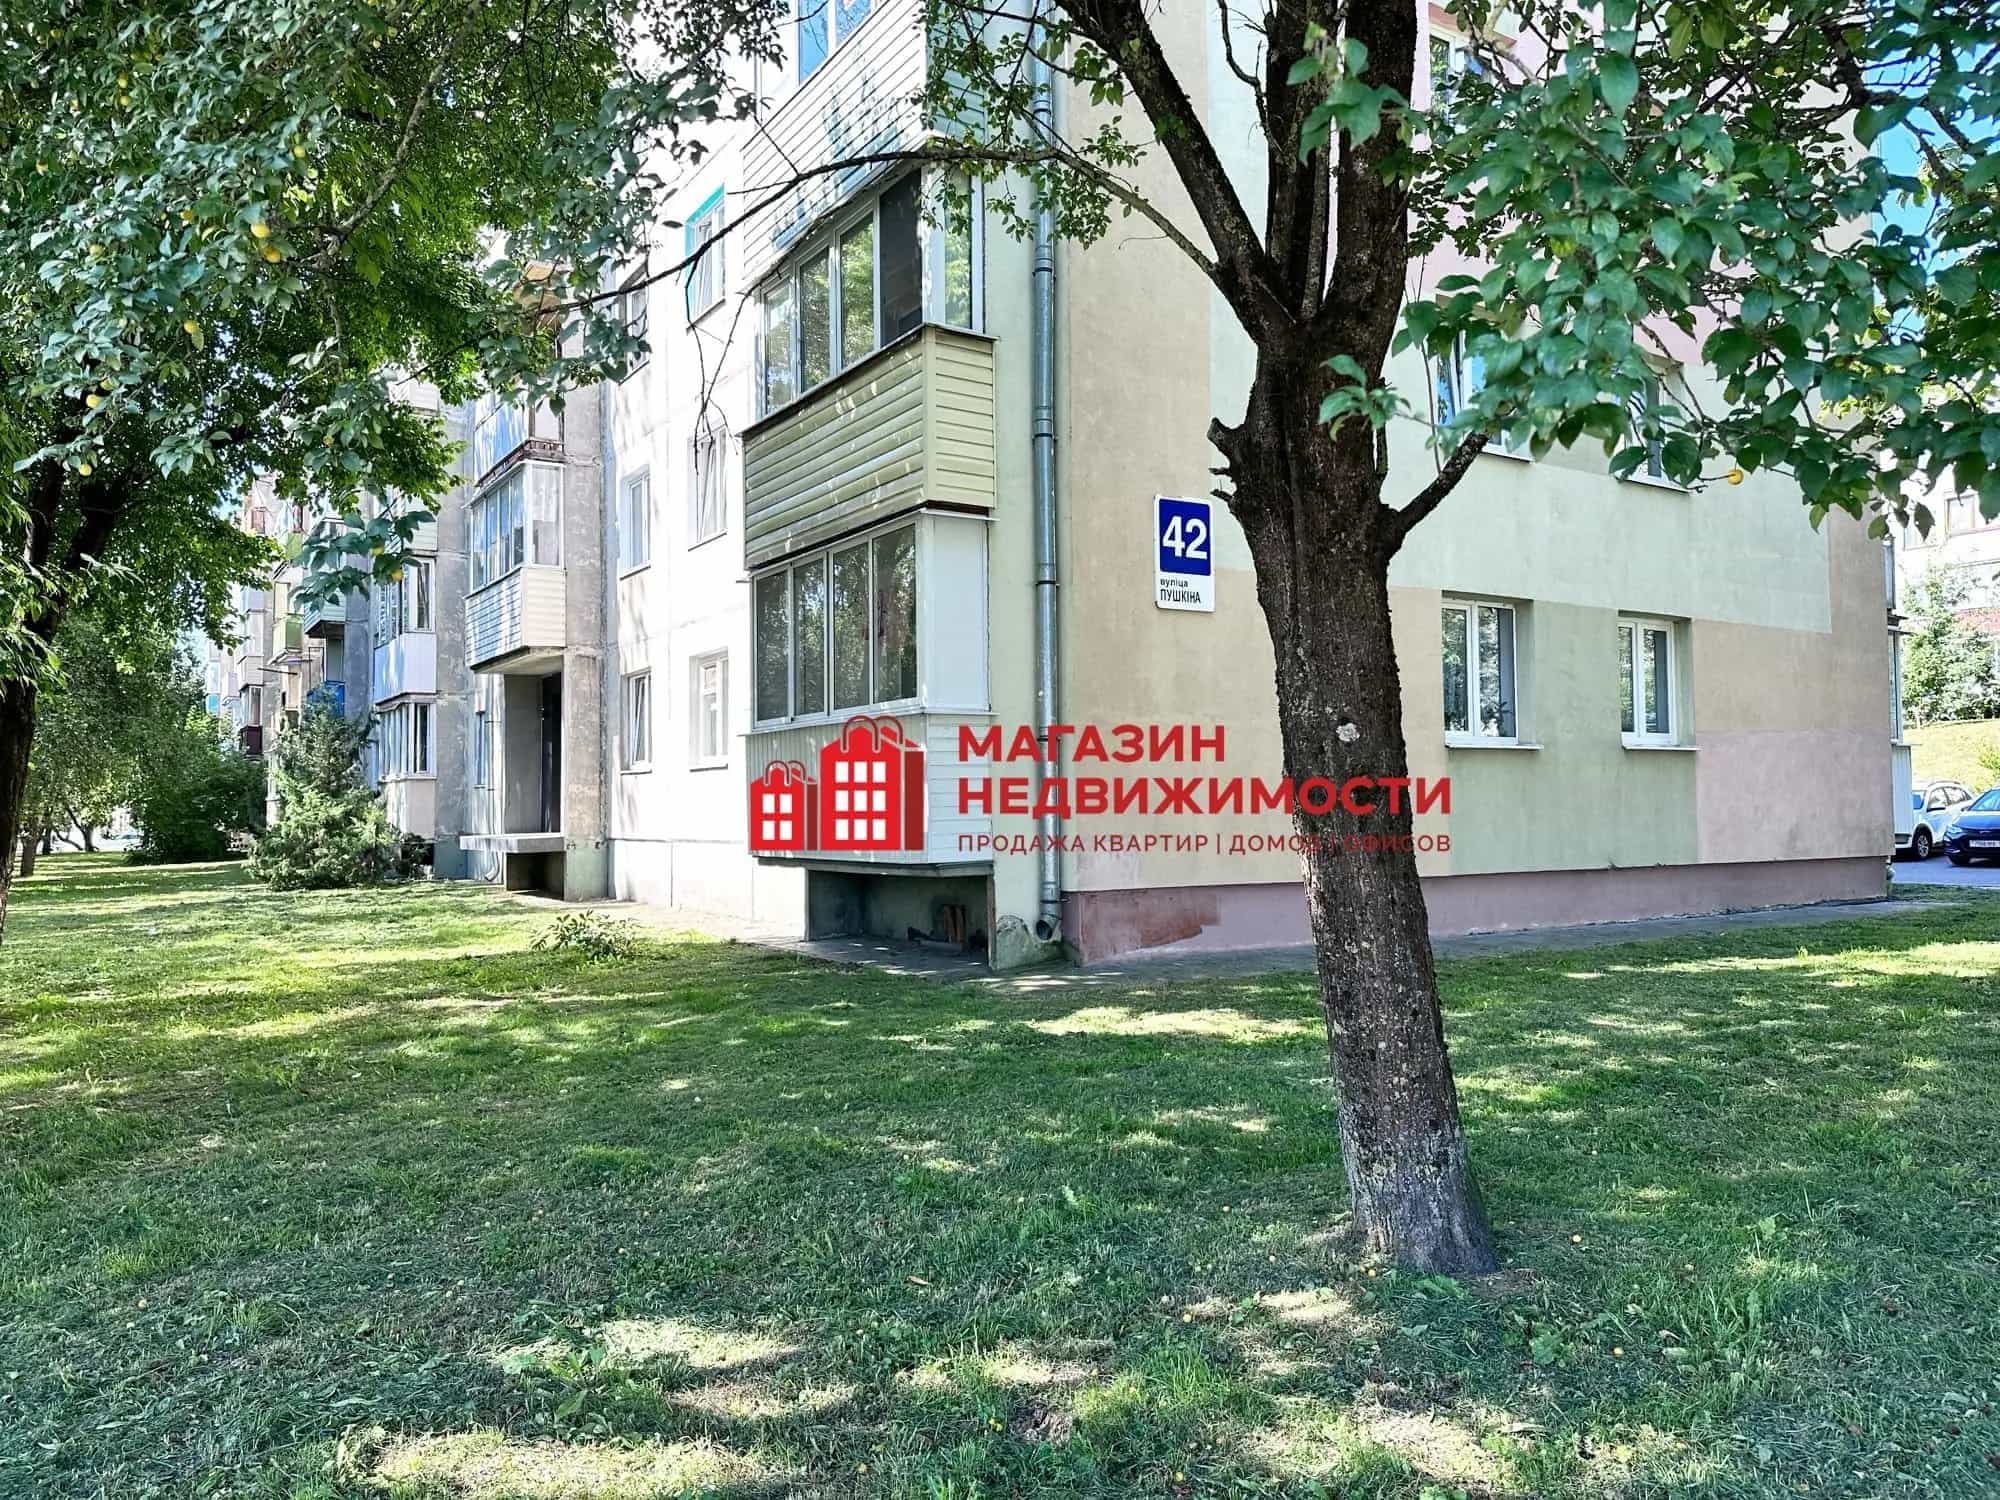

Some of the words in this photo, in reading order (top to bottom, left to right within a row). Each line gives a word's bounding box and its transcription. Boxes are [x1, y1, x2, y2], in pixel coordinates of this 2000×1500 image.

[1162, 515, 1208, 560] 42
[1160, 578, 1189, 588] вуліца
[1160, 588, 1201, 603] ПУШКІНА
